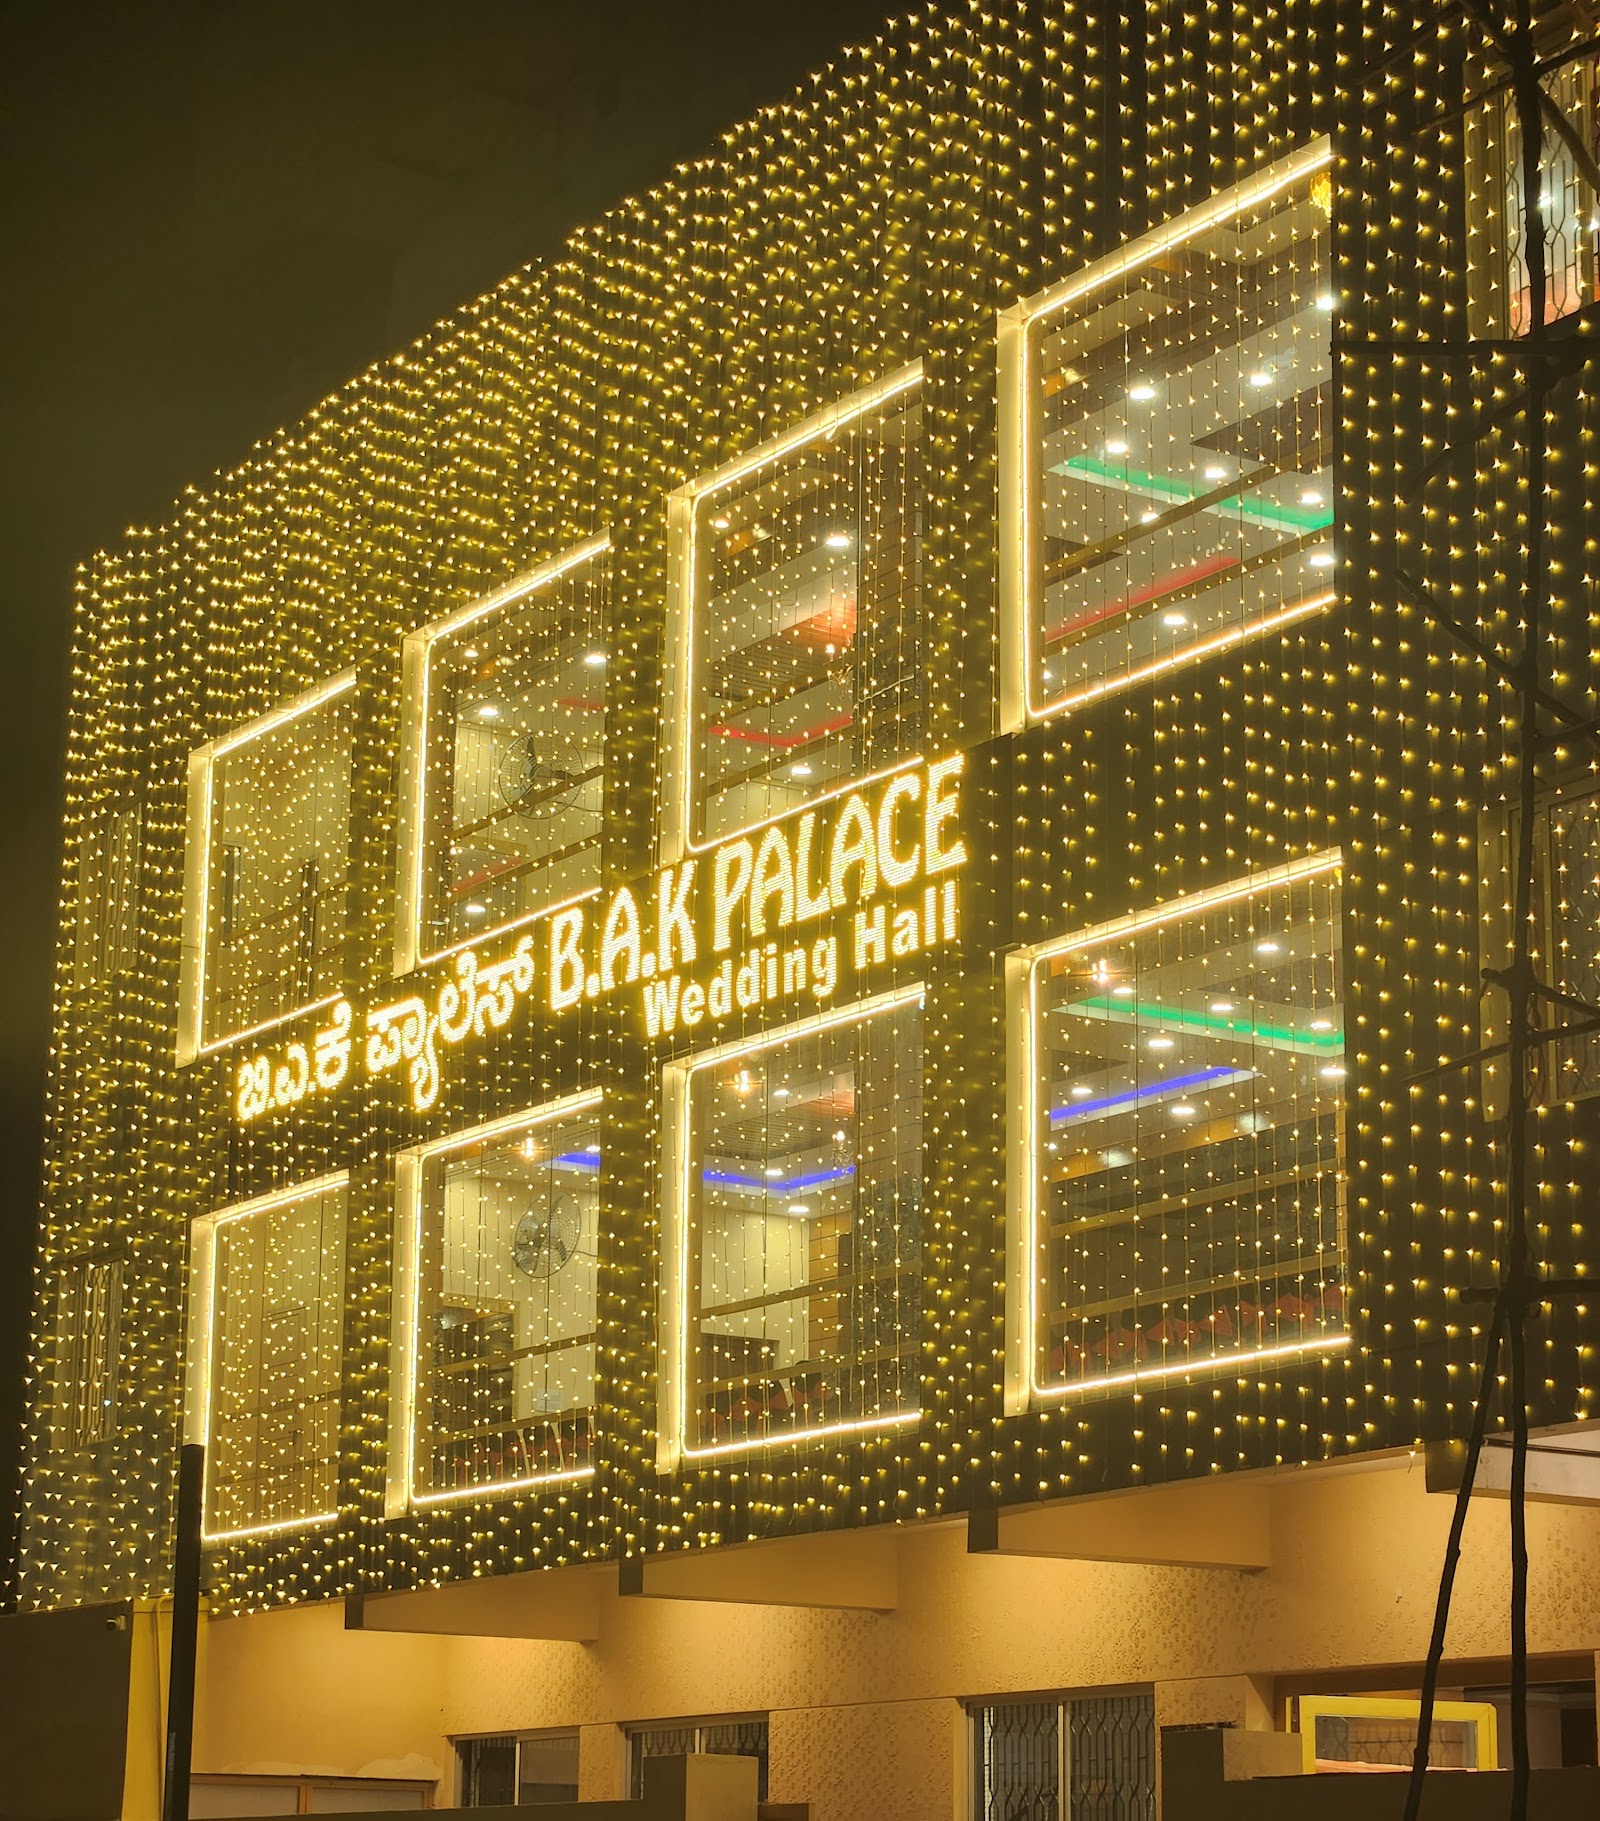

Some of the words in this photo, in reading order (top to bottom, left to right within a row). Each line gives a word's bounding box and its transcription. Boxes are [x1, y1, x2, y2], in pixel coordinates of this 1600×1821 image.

[549, 858, 698, 1011] B.A.K
[713, 753, 968, 951] PALACE
[643, 936, 838, 1038] Wedding
[853, 880, 957, 969] Hall
